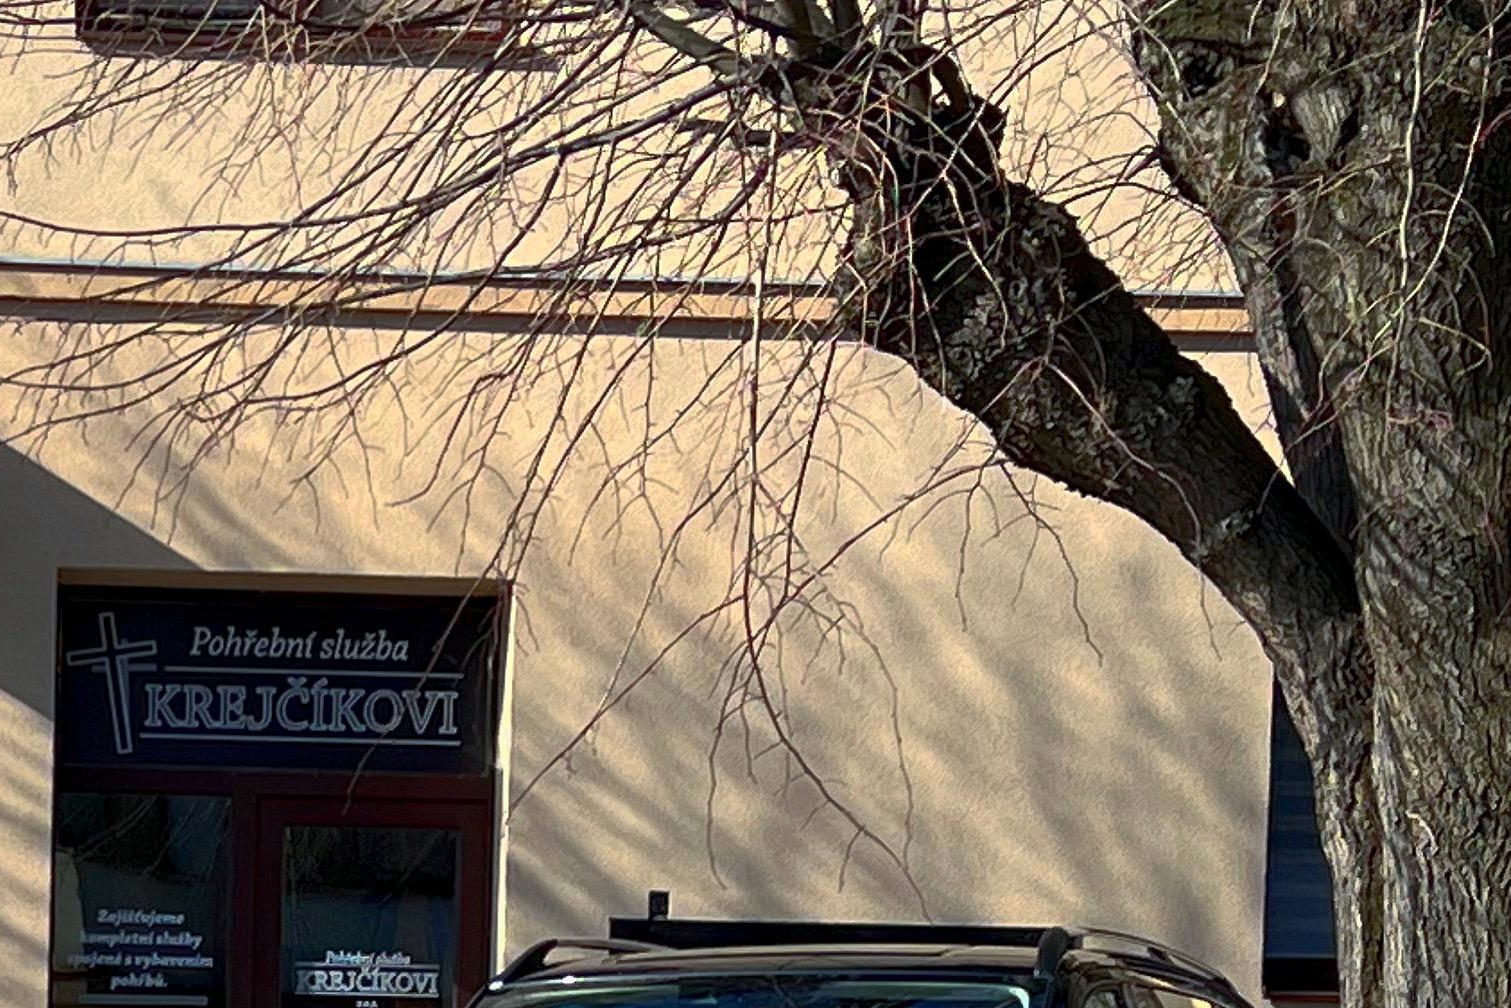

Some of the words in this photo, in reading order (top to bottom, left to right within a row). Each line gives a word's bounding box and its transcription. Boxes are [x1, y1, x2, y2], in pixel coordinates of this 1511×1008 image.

[189, 625, 317, 658] Pohřební
[320, 628, 409, 661] služba
[144, 676, 459, 734] KREJČÍKOVI
[156, 931, 203, 949] služby
[296, 966, 439, 994] KREJČÍKOVI
